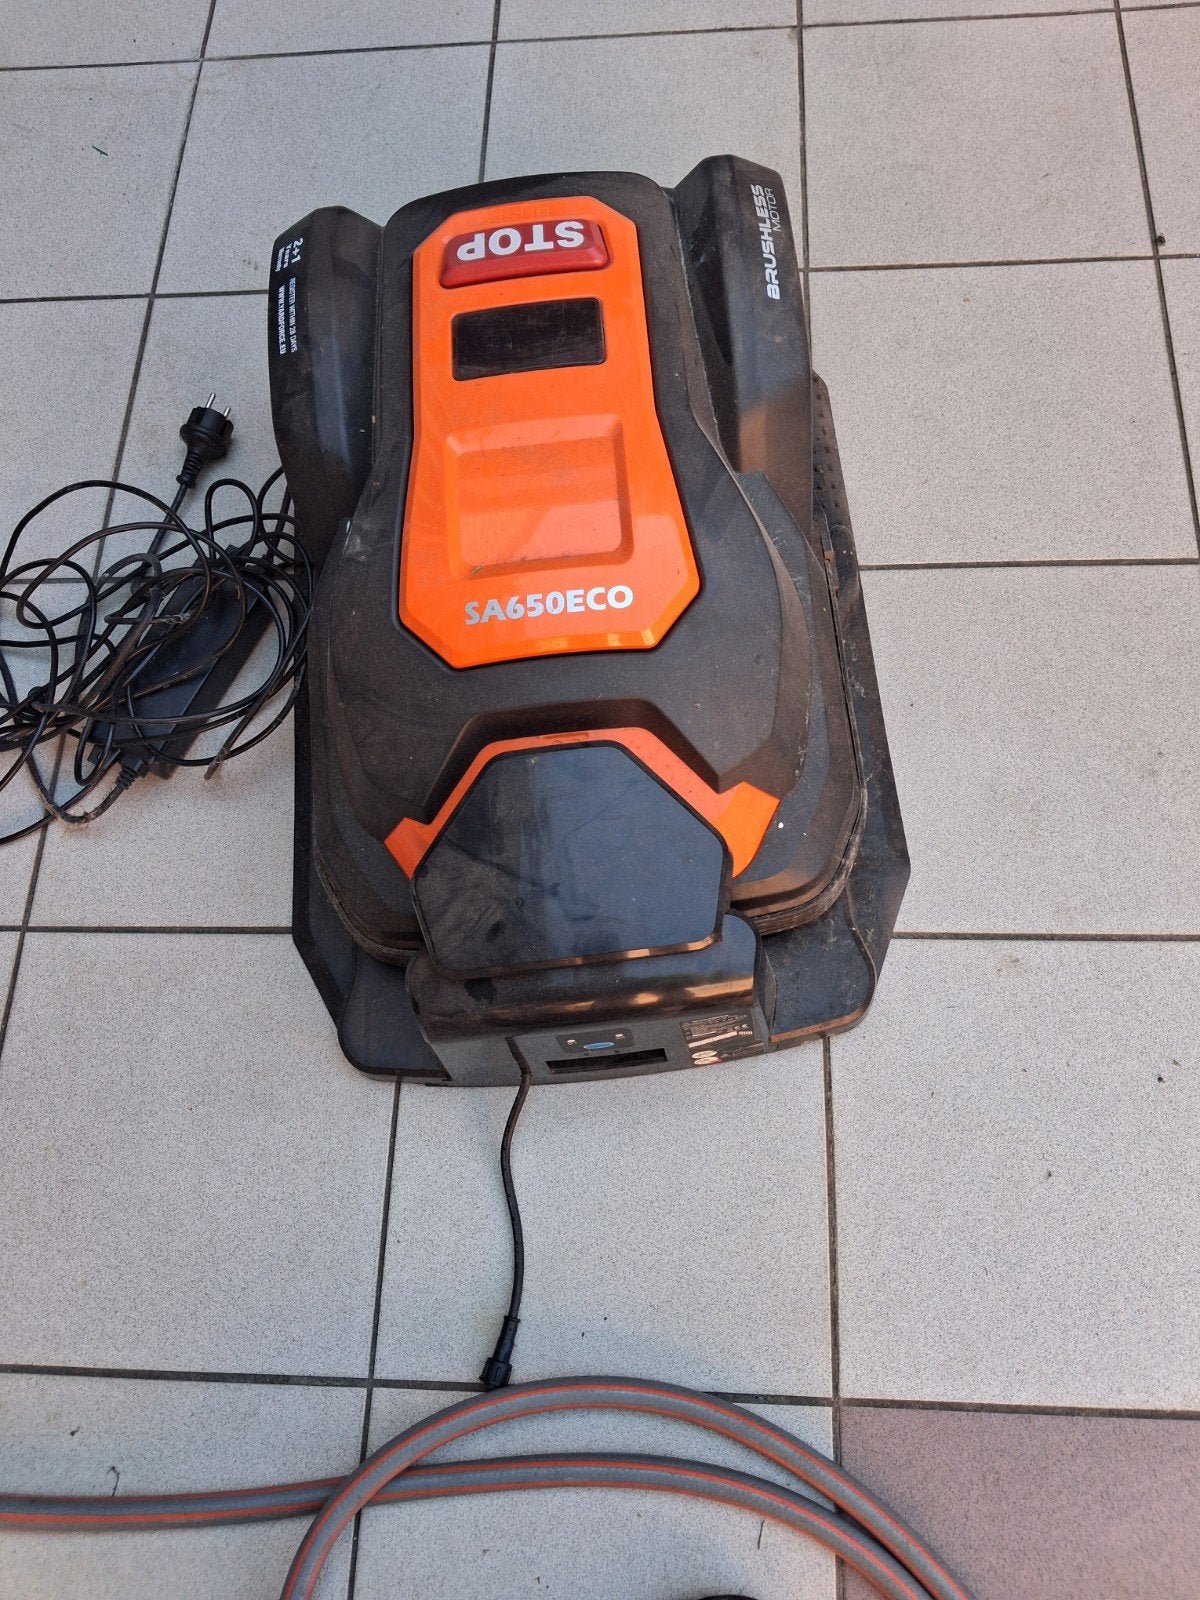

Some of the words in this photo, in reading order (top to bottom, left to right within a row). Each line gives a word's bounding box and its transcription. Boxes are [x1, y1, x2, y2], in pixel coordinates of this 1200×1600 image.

[764, 187, 782, 232] MOTOR
[292, 237, 304, 263] 2+1
[456, 220, 585, 261] STOP
[750, 184, 781, 300] BRUSHLESS
[290, 335, 298, 353] DAYS
[464, 585, 634, 625] SA650ECO
